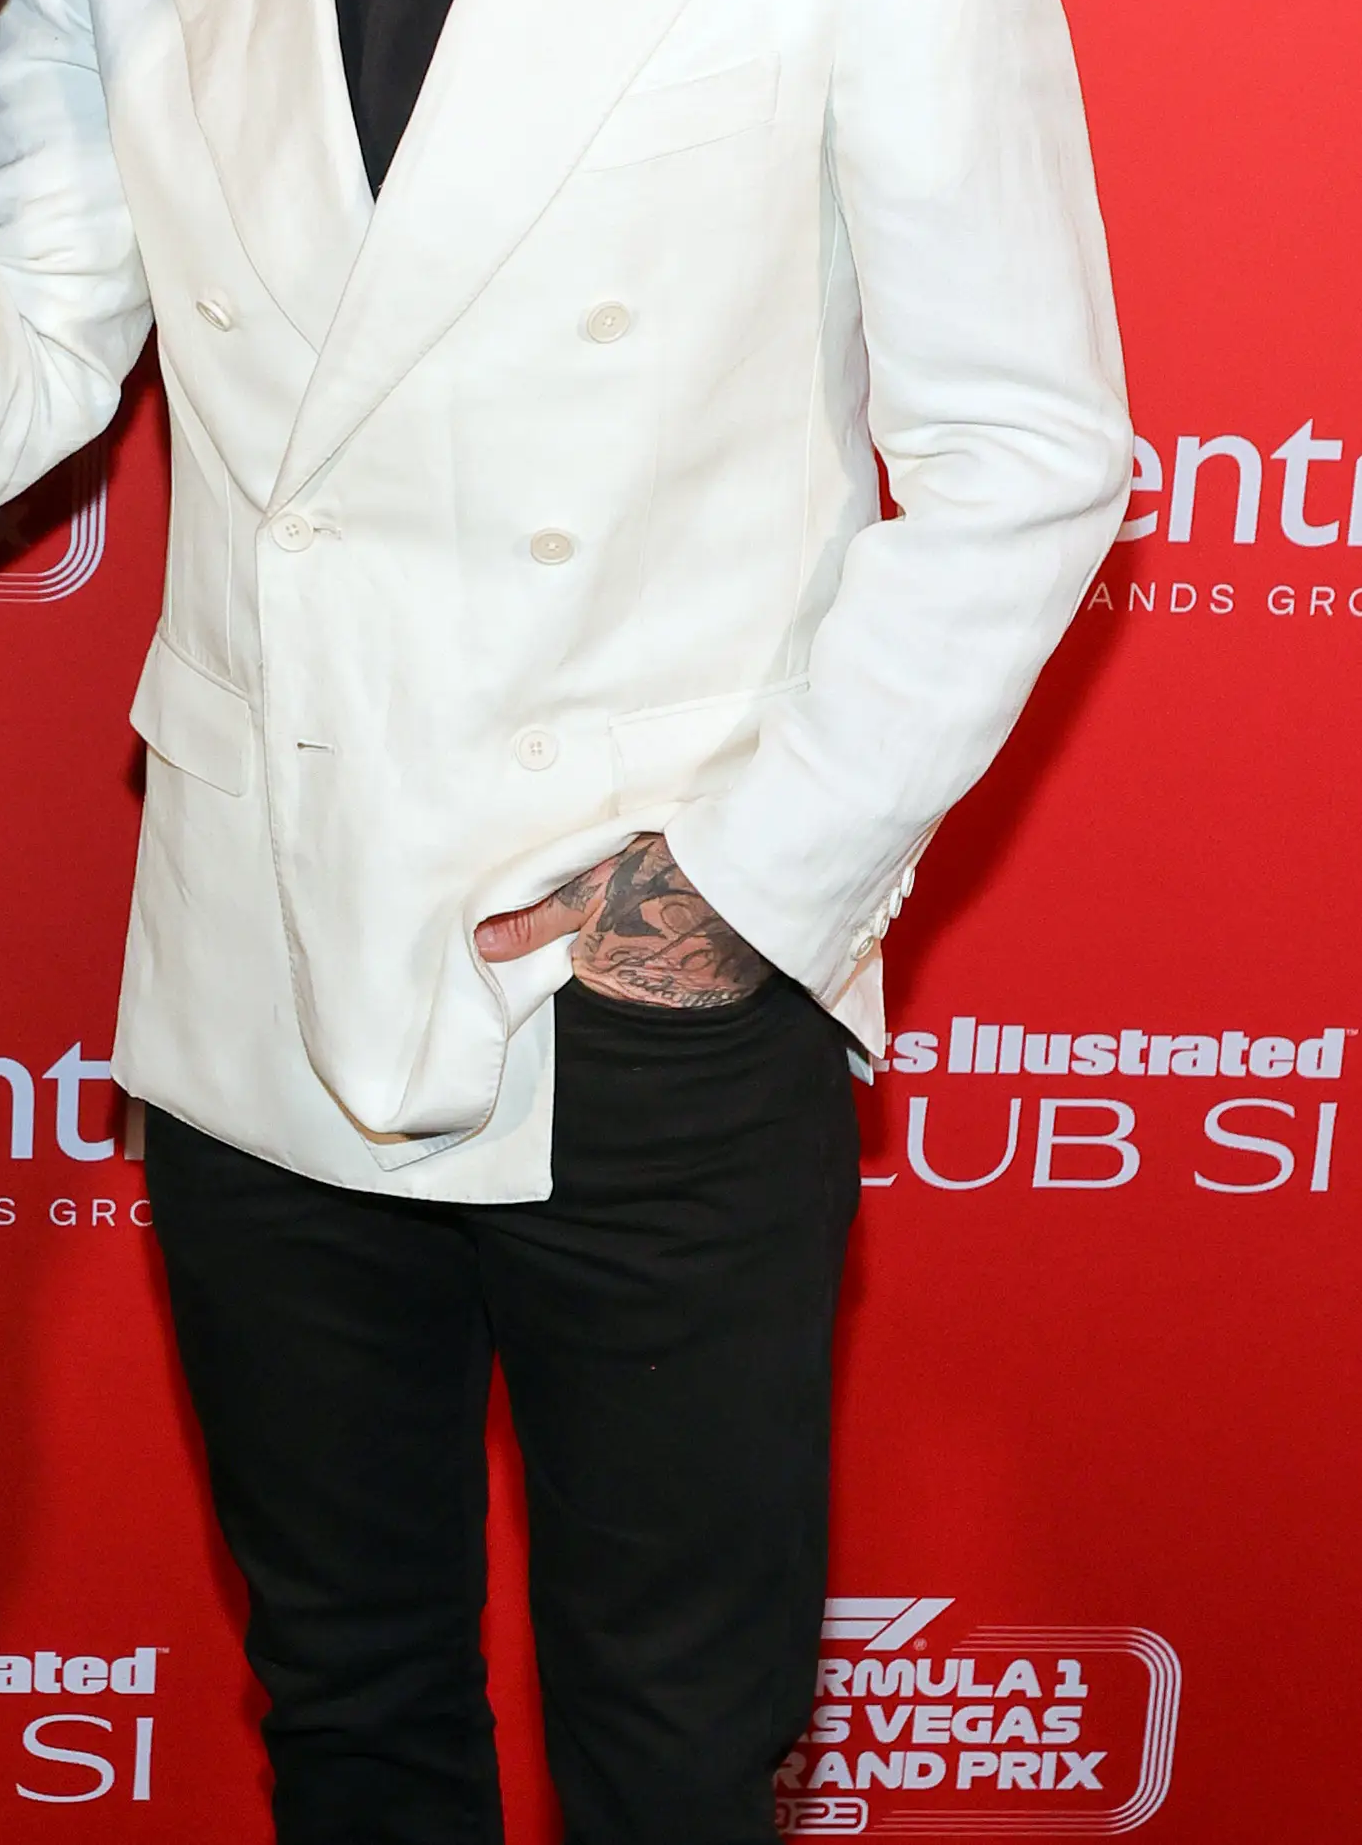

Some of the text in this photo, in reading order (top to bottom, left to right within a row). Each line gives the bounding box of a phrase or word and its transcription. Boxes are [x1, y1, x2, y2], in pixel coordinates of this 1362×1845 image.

[948, 1016, 1346, 1079] Illustrated
[861, 1097, 1339, 1194] UB SI
[1056, 1658, 1088, 1699] 1
[801, 1704, 1083, 1745] S VEGAS
[15, 1714, 154, 1803] SI
[957, 1751, 1107, 1791] PRIX
